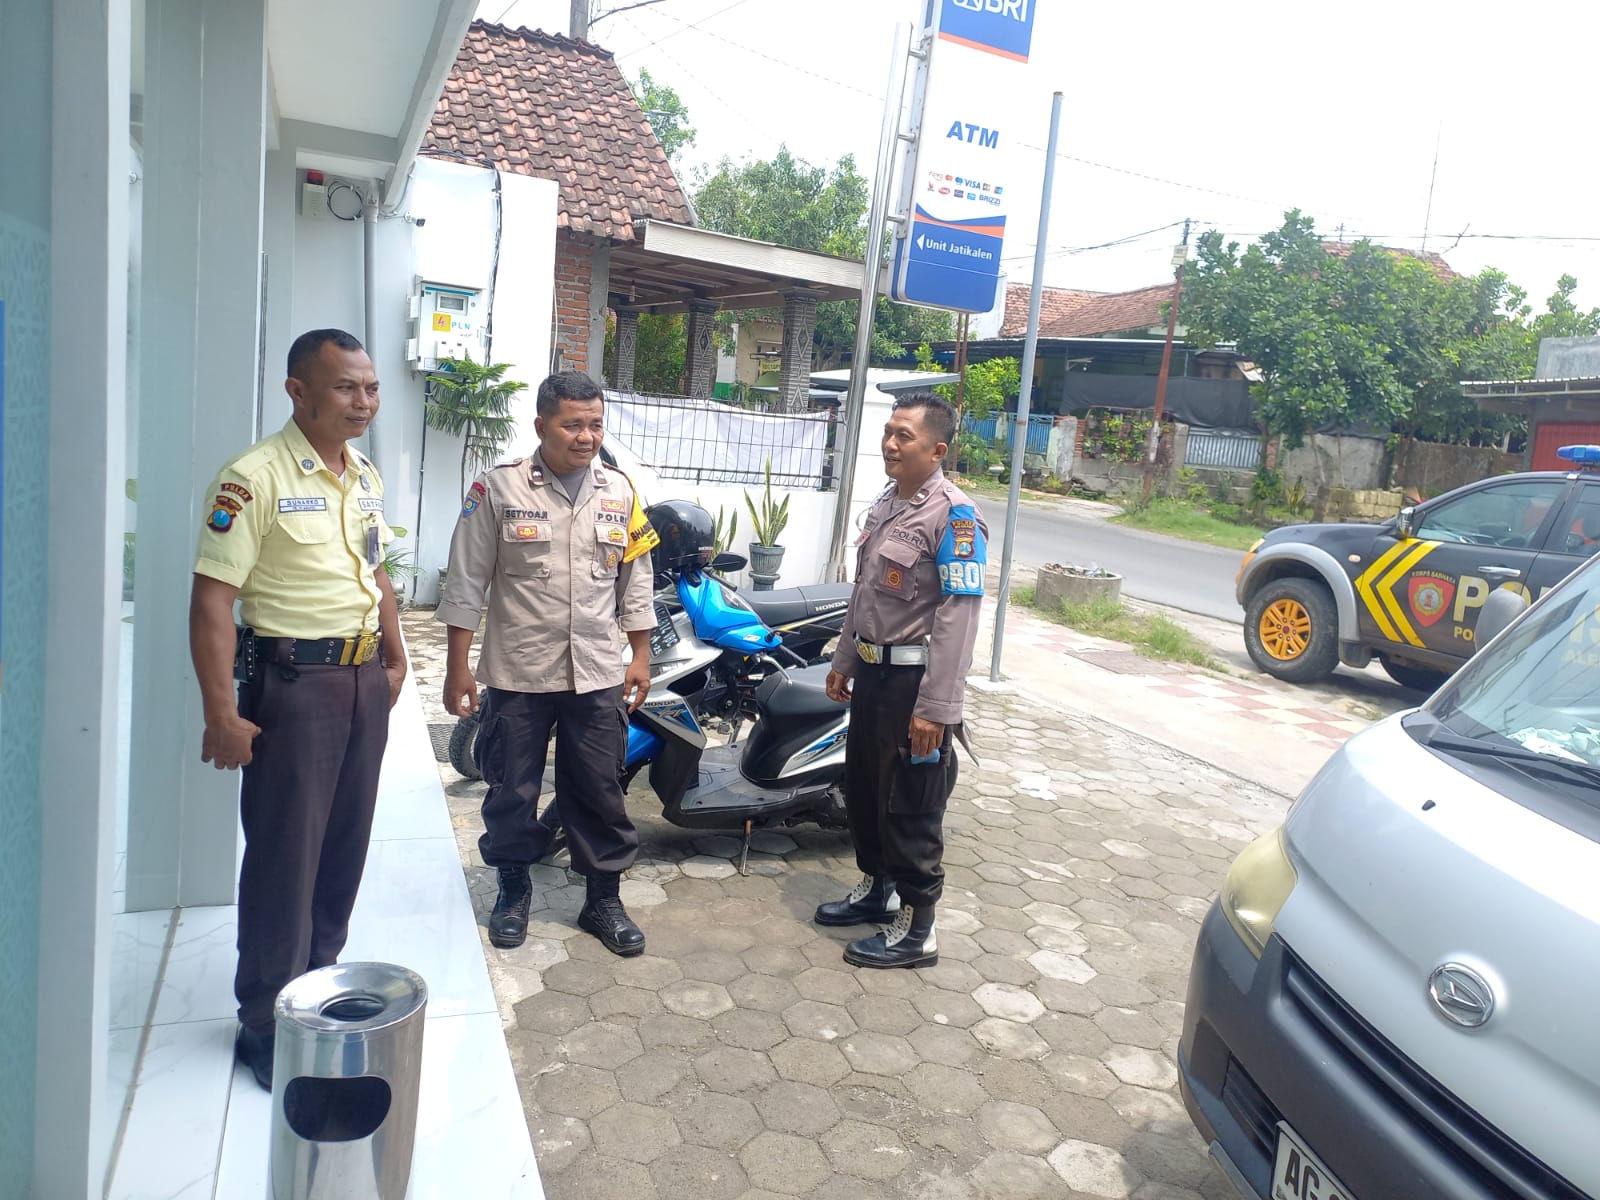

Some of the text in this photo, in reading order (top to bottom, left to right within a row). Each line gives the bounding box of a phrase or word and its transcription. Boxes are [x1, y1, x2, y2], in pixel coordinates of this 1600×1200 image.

[946, 120, 999, 149] ATM
[964, 178, 981, 190] VISA
[926, 238, 993, 260] Unit Jatikalen
[452, 321, 470, 330] PLN
[223, 484, 250, 499] POLDA
[361, 500, 383, 509] SATP
[505, 510, 548, 519] SETYOAJI
[815, 600, 848, 611] HONDA
[1284, 1148, 1320, 1200] AG
